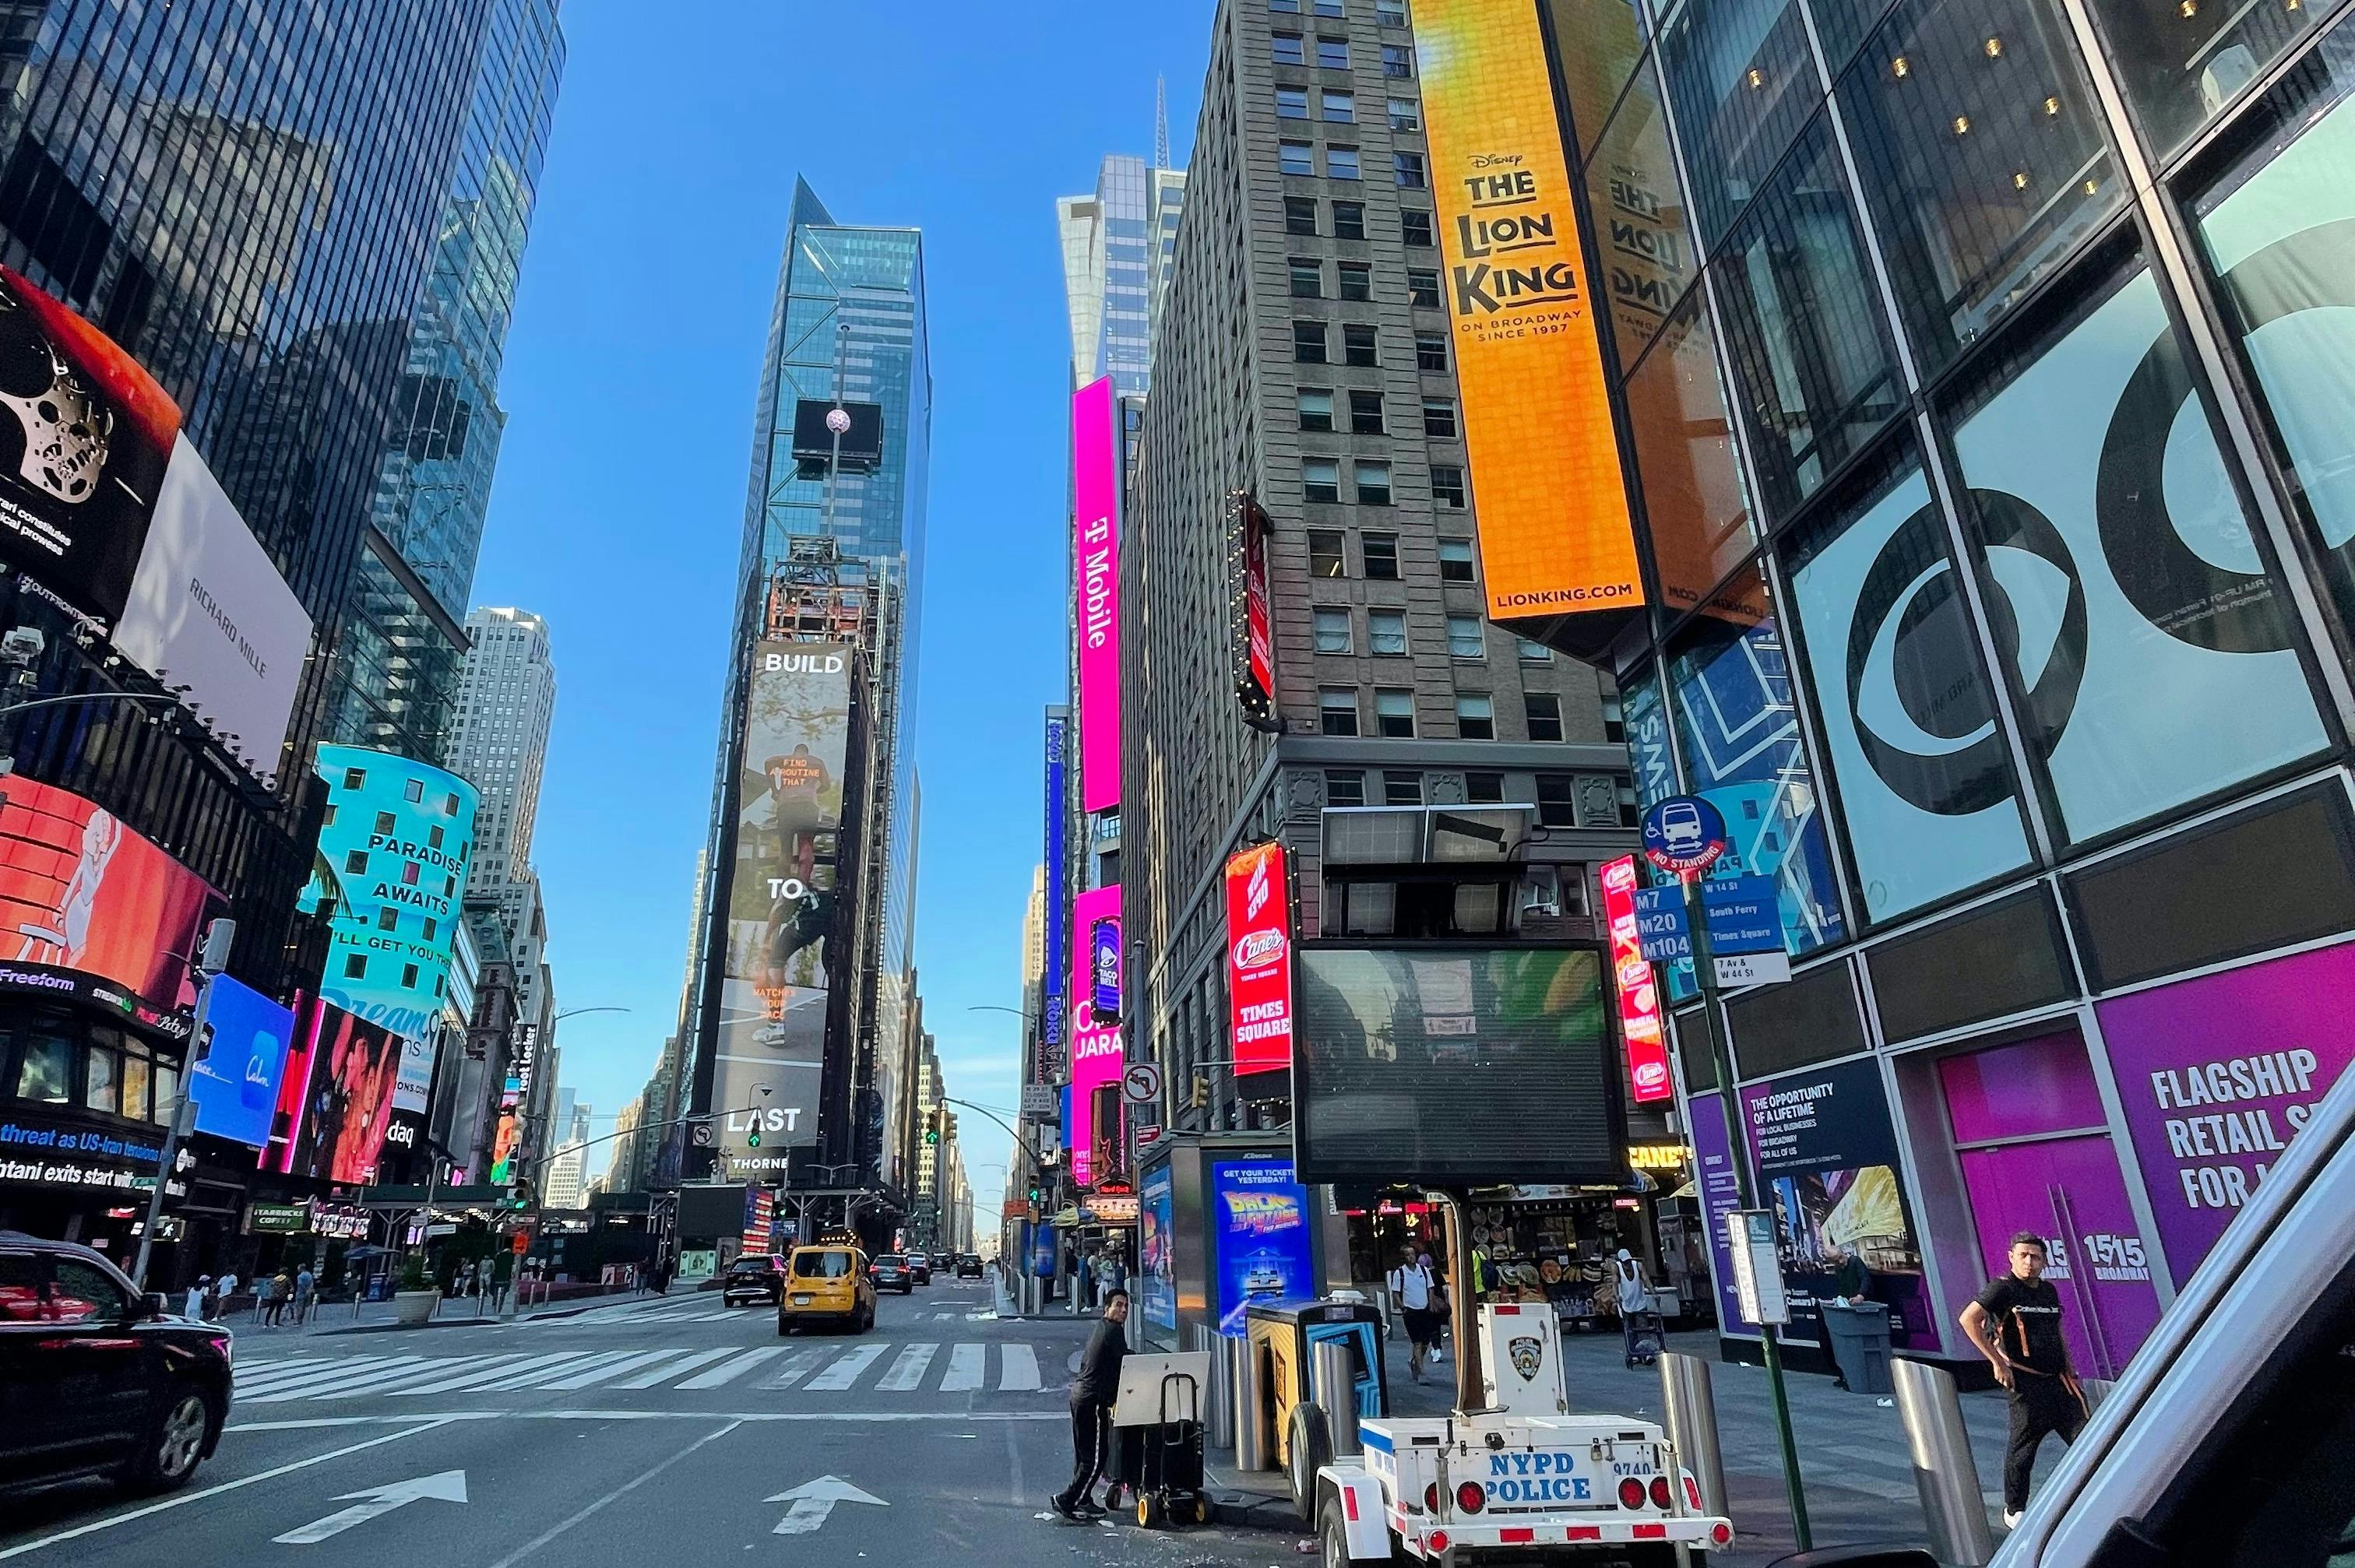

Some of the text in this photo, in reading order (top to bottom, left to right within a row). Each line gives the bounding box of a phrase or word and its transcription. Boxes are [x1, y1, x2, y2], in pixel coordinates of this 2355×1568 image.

[1464, 171, 1536, 201] THE
[1457, 213, 1553, 259] LION
[1452, 263, 1576, 315] KING
[1462, 309, 1582, 333] ON BROADWAY
[1478, 323, 1568, 343] SINCE 1997
[0, 511, 64, 556] ical prowess
[17, 508, 72, 547] constitutes
[1085, 546, 1111, 649] Mobile
[1497, 583, 1633, 609] LIONKING.COM
[190, 578, 267, 679] RICHARD MILLE
[765, 653, 843, 674] BUILD
[781, 768, 820, 778] ROUTINE
[368, 835, 462, 877] PARADISE
[1653, 852, 1668, 866] NO
[1670, 846, 1720, 869] STANDING
[371, 882, 449, 916] AWAITS
[766, 878, 804, 899] TO
[1705, 881, 1738, 893] W 14 St
[1636, 891, 1660, 910] M7
[1709, 905, 1758, 917] South Ferry
[1639, 913, 1677, 933] M20
[1713, 928, 1771, 941] Times Square
[368, 937, 403, 952] GET
[408, 944, 435, 962] YOU
[1234, 930, 1283, 968] Cane's
[1643, 936, 1690, 958] M104
[1099, 969, 1118, 979] TACO
[1727, 958, 1738, 967] Av
[0, 969, 75, 991] Freeform
[1100, 978, 1118, 988] BELL
[1240, 1000, 1285, 1023] TIMES
[1237, 1018, 1290, 1043] SQUARE
[520, 1025, 536, 1064] Locker
[246, 1055, 269, 1088] Calm
[2151, 1048, 2318, 1110] FLAGSHIP
[1751, 1082, 1834, 1112] THE OPPORTUNITY
[727, 1108, 801, 1133] LAST
[1754, 1102, 1815, 1125] OF A LIFETIME
[1, 1124, 56, 1146] threat
[58, 1134, 76, 1149] as
[79, 1132, 123, 1156] US-Iran
[385, 1120, 414, 1149] daq
[1766, 1125, 1783, 1134] LOCAL
[2165, 1109, 2284, 1158] RETAIL
[732, 1158, 788, 1170] THORNE
[1771, 1149, 1780, 1158] ALL
[1781, 1148, 1789, 1156] OF
[1789, 1146, 1797, 1155] US
[44, 1163, 83, 1184] exits
[83, 1168, 114, 1187] start
[1223, 1170, 1240, 1179] GET
[1241, 1169, 1263, 1178] YOUR
[2180, 1164, 2249, 1208] FOR
[2083, 1234, 2147, 1267] 15/15
[2094, 1266, 2150, 1281] BROADWAY
[1490, 1453, 1574, 1476] NYPD
[1486, 1477, 1591, 1502] POLICE
